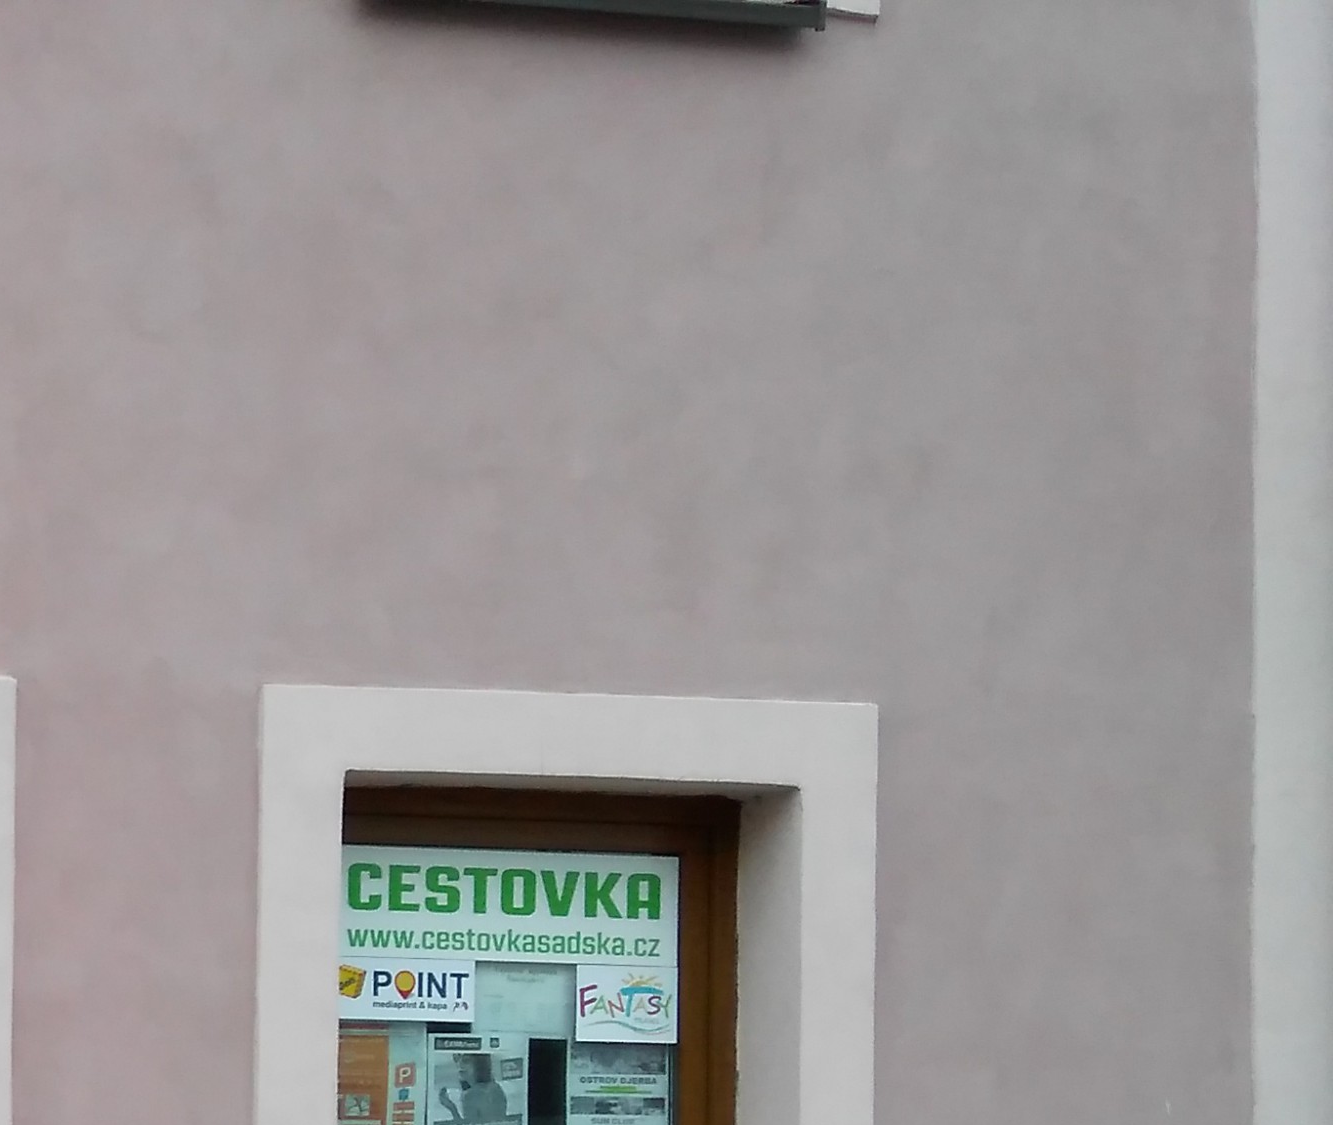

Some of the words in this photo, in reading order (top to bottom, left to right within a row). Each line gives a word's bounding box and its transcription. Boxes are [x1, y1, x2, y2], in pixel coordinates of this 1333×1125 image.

[347, 862, 661, 919] CESTOVKA
[347, 928, 661, 957] www.cestovkasadska.cz
[372, 969, 470, 999] POINT
[372, 1001, 417, 1010] mediaprint
[579, 984, 672, 1018] FANTASY
[579, 1076, 619, 1084] OSTROV
[620, 1077, 657, 1085] DJERBA
